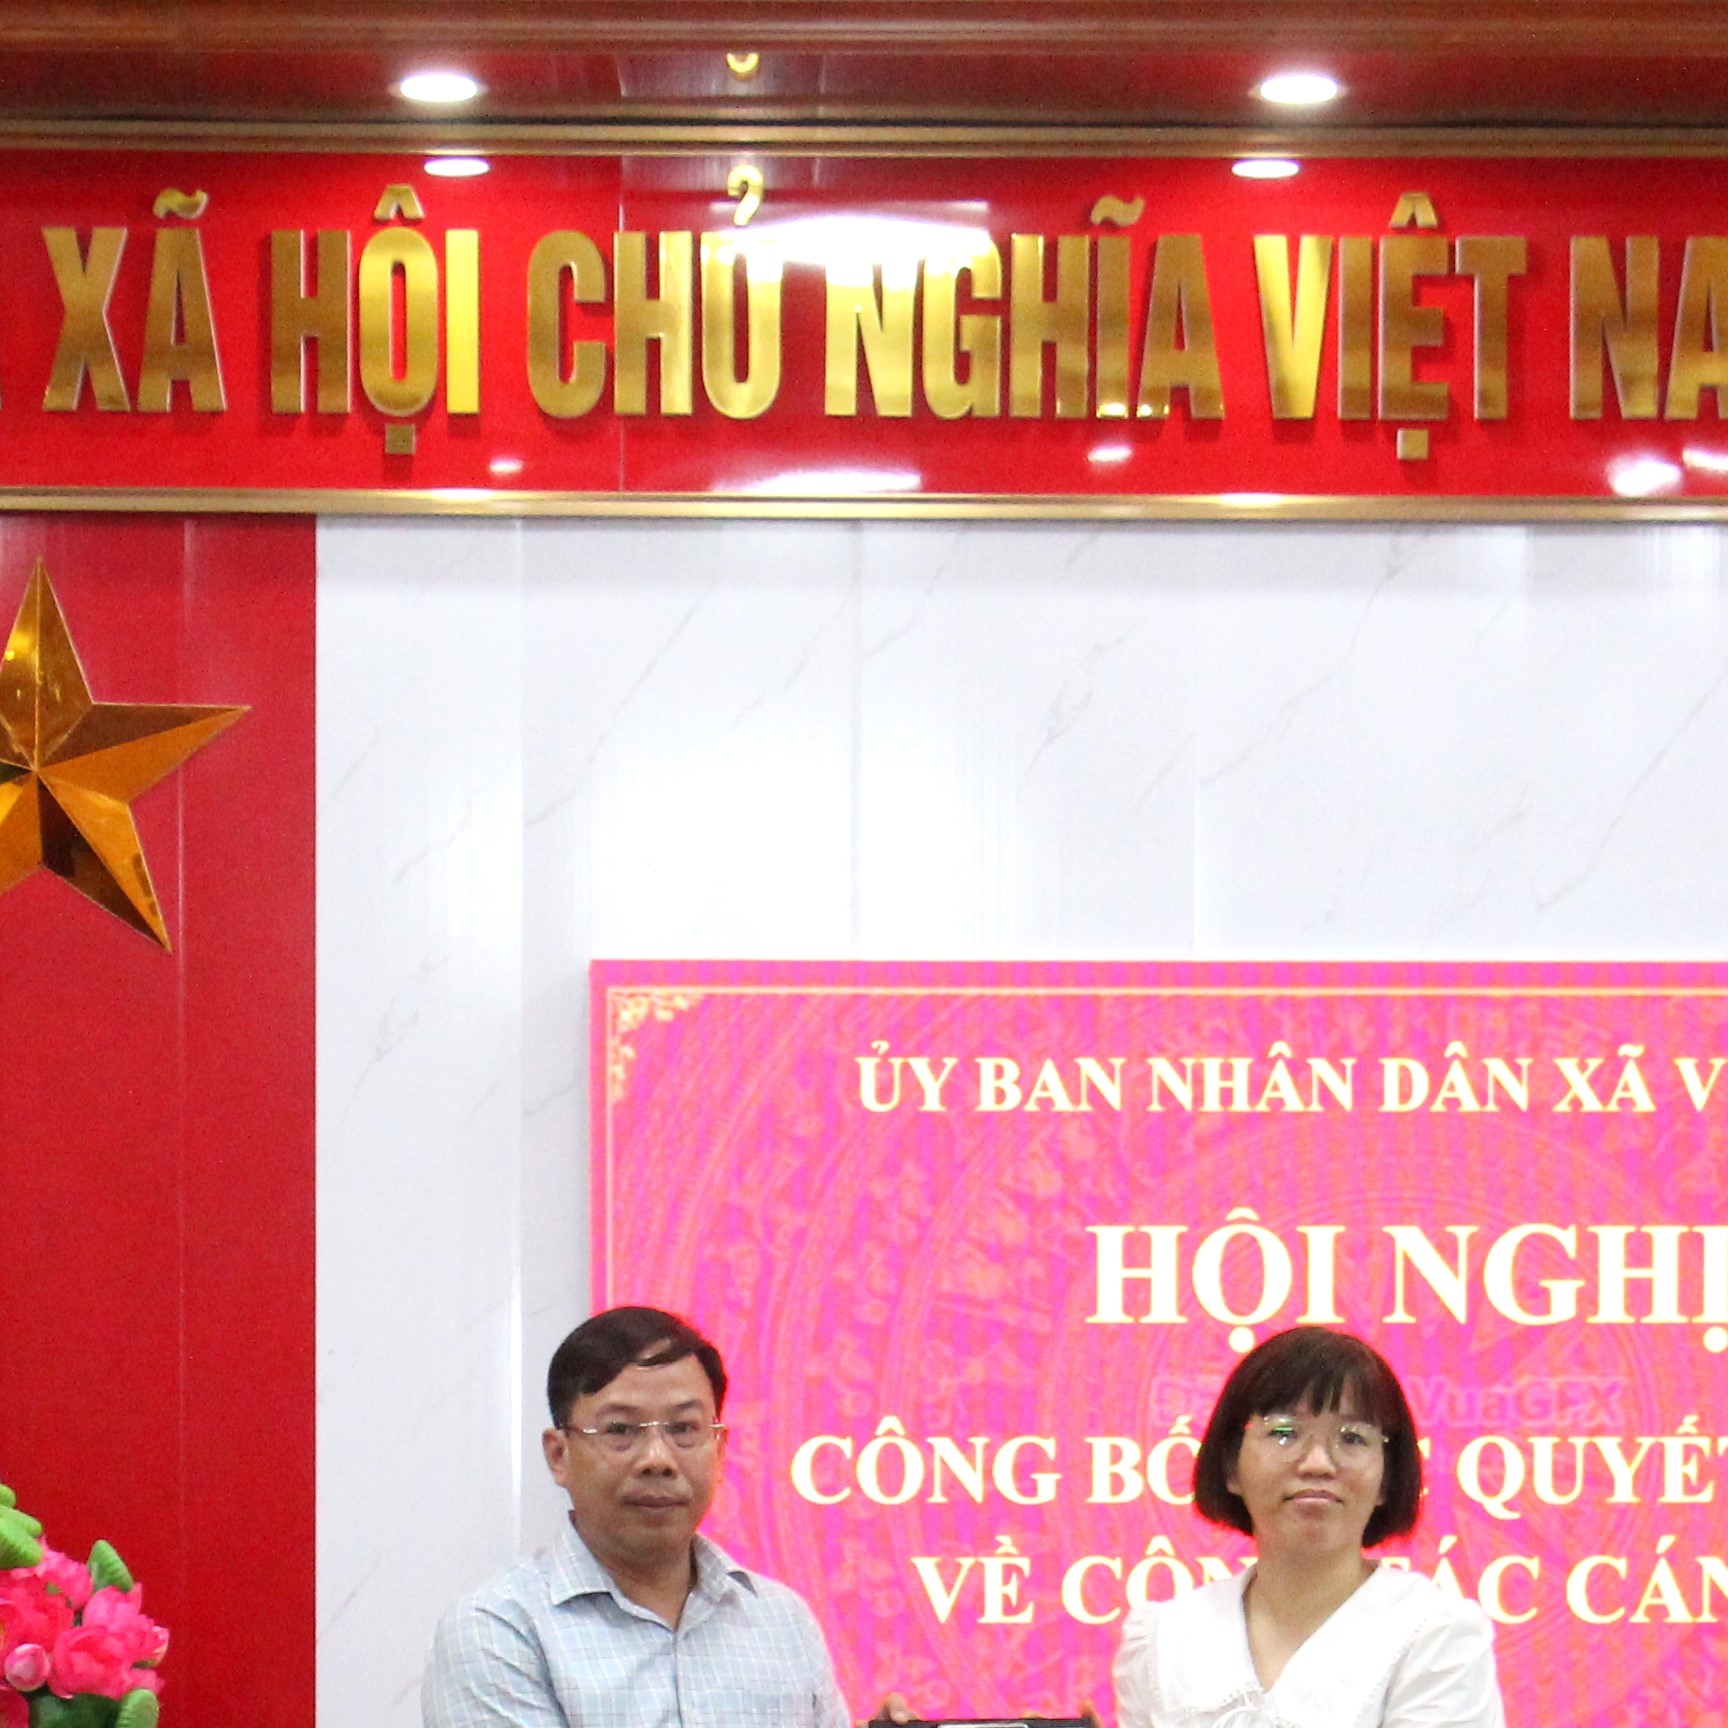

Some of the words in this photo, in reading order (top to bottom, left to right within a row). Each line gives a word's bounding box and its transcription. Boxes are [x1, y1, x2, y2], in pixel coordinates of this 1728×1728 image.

[40, 187, 228, 414] XÃ
[271, 183, 480, 456] HỘI
[526, 164, 783, 419] CHỦ
[823, 194, 1225, 420] NGHĨA
[1253, 191, 1528, 460] VIỆT
[854, 1040, 959, 1114] ỦY
[974, 1057, 1128, 1114] BAN
[1146, 1040, 1358, 1114] NHÂN
[1379, 1040, 1535, 1114] DÂN
[1552, 1043, 1657, 1114] XÃ
[1084, 1206, 1344, 1354] HỘI
[789, 1414, 1063, 1506] CÔNG
[910, 1534, 1036, 1625] VỀ
[1381, 1534, 1541, 1625] ÁC
